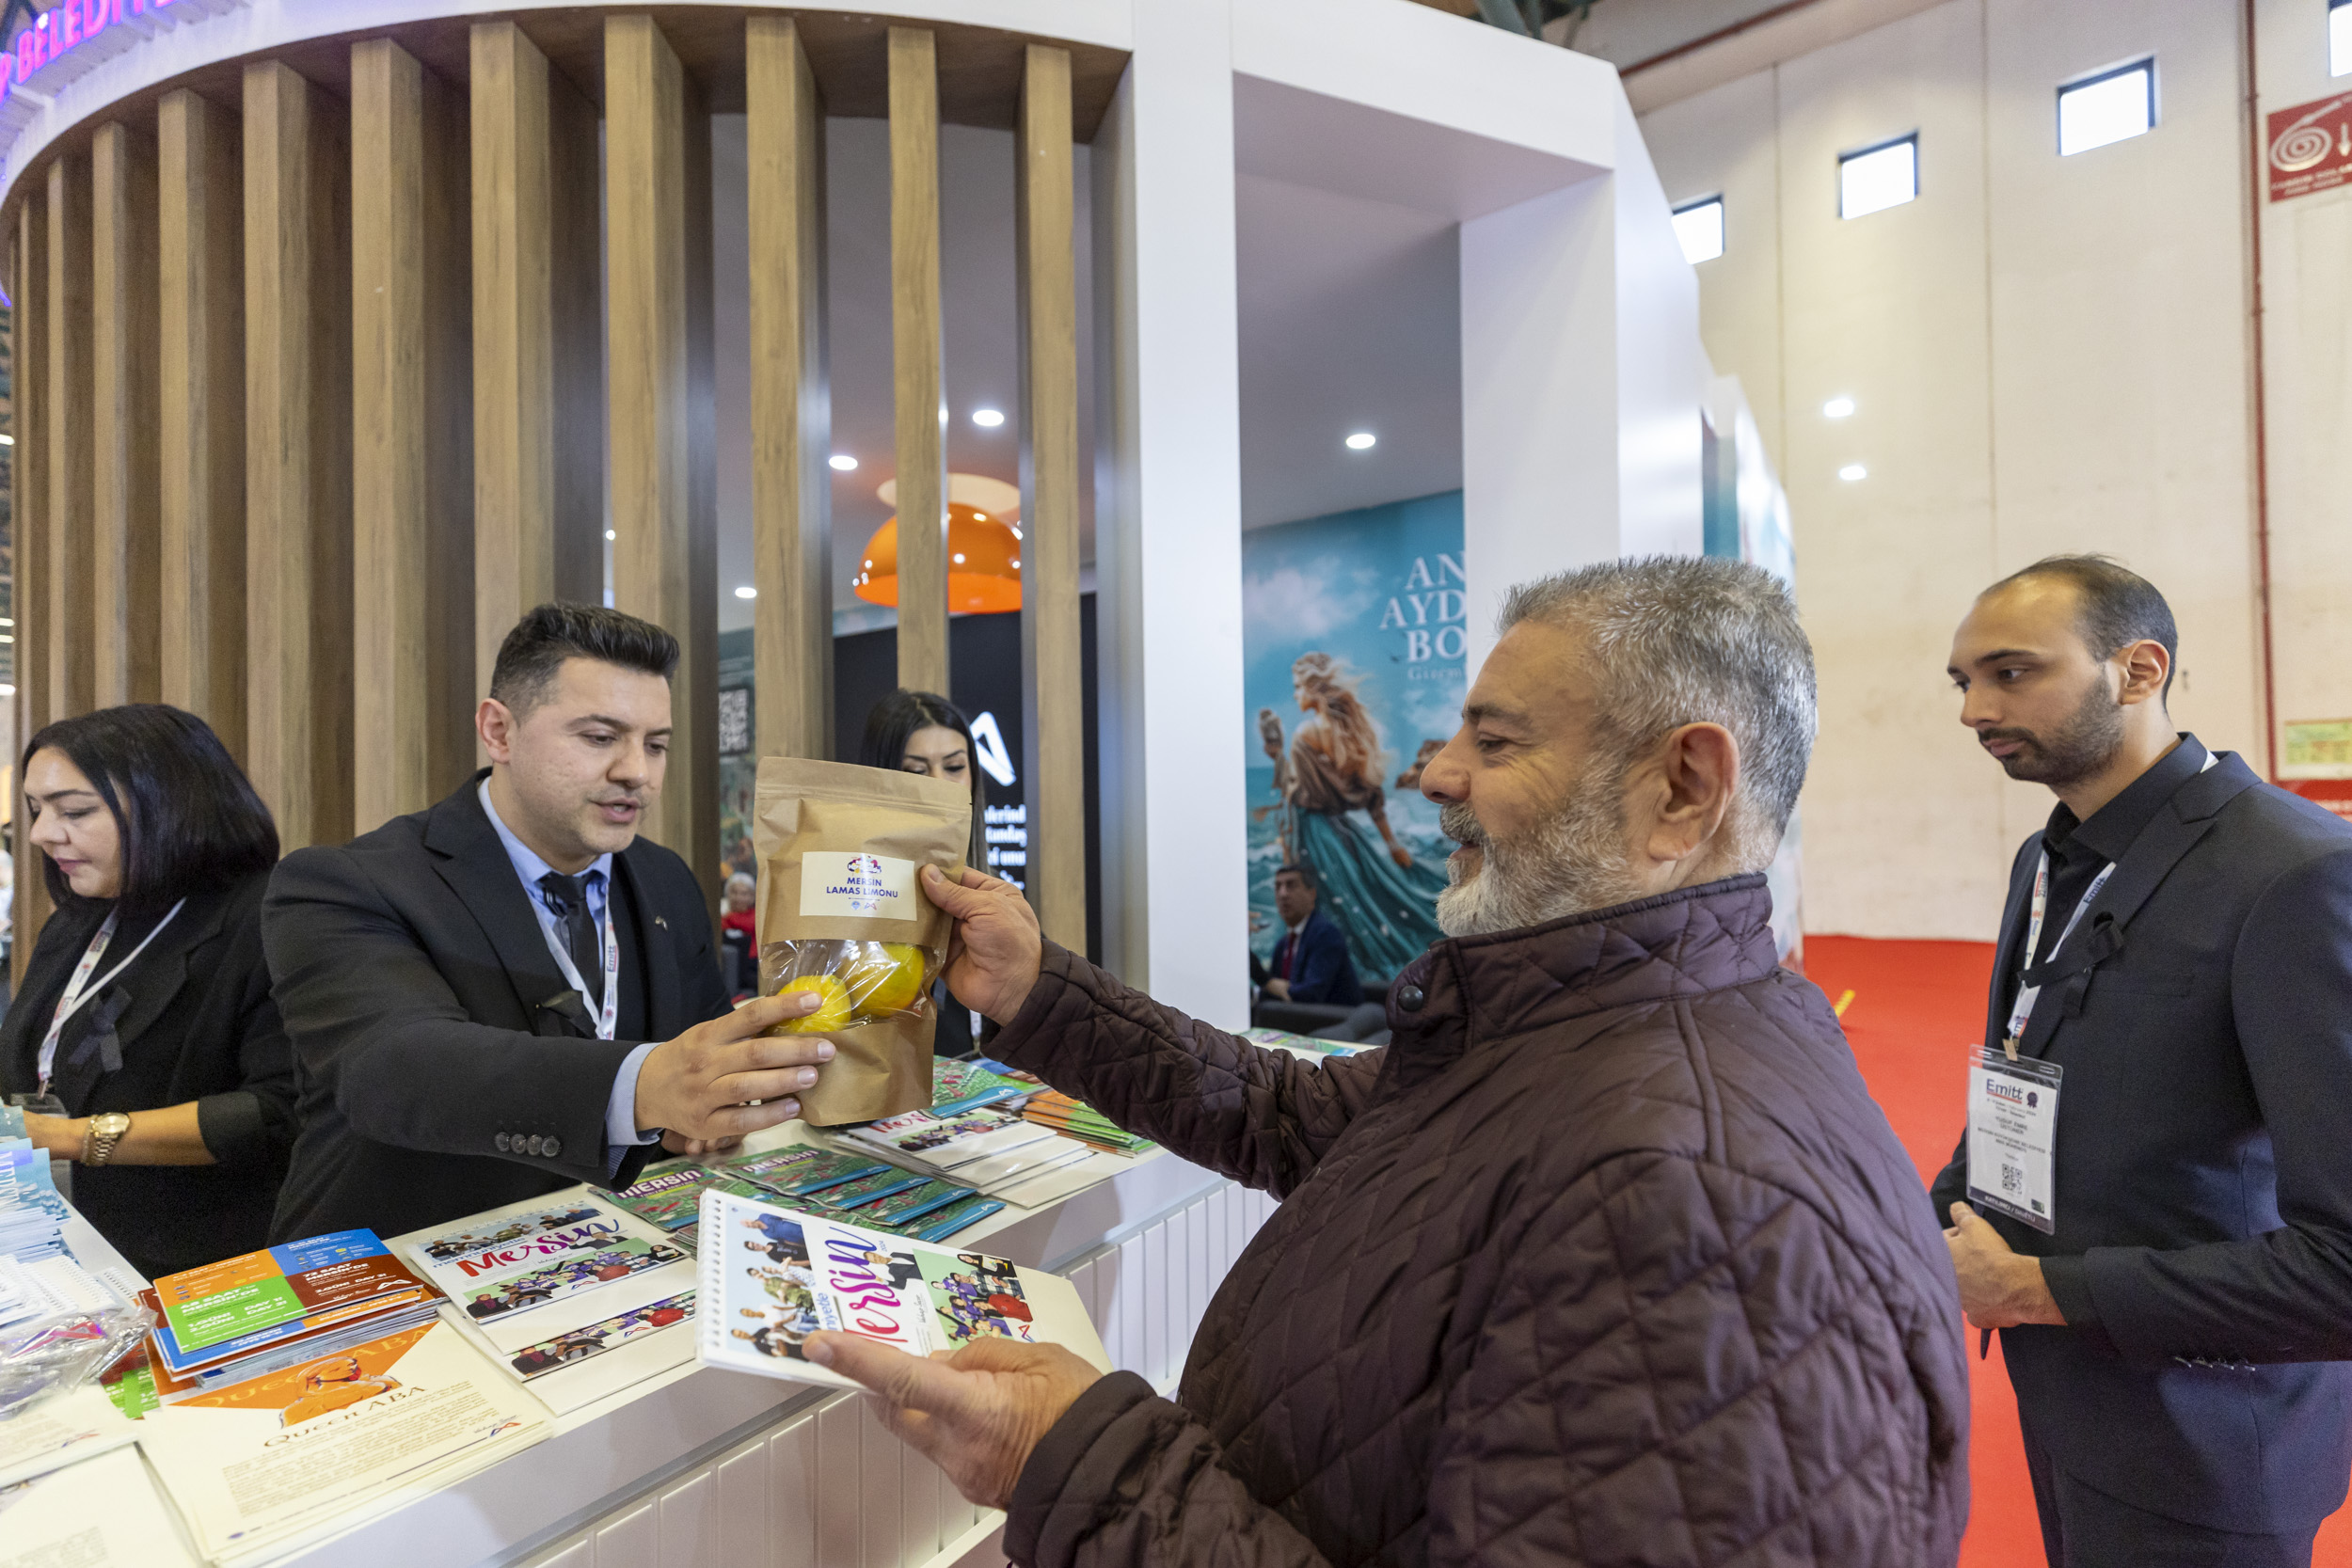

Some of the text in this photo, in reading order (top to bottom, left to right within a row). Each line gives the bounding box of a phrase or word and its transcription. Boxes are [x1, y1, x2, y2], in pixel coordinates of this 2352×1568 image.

[847, 876, 882, 887] MERSİN
[826, 886, 860, 895] LAMAS
[1986, 1078, 2024, 1101] Emitt
[455, 1219, 620, 1277] Mersin
[355, 1275, 377, 1283] DAY
[202, 1289, 241, 1303] SAAT
[244, 1300, 270, 1311] DAY
[246, 1305, 272, 1315] DAY
[369, 1386, 426, 1411] ABA
